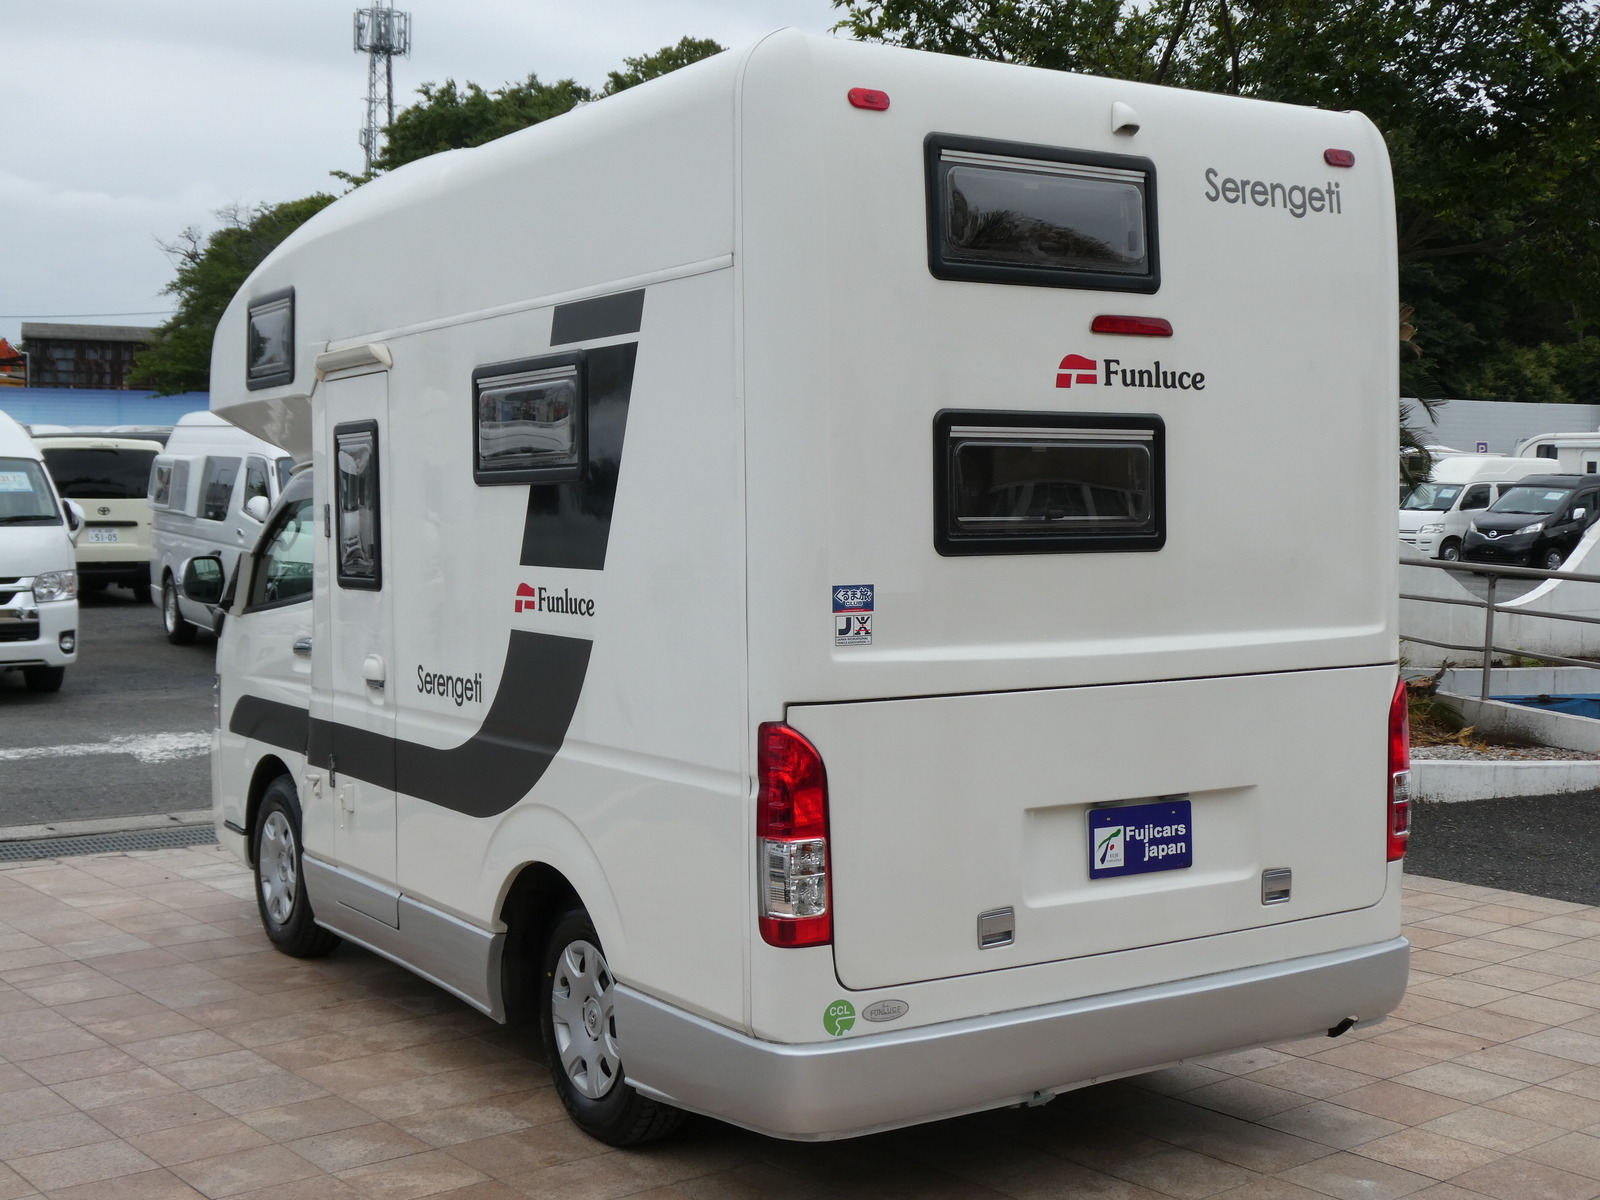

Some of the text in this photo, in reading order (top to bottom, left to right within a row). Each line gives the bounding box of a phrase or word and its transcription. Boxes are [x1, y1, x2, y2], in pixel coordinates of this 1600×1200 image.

[1204, 167, 1342, 219] Serengeti
[1103, 358, 1206, 391] Funluce
[537, 586, 595, 617] Funluce
[834, 587, 873, 603] くるま旅
[417, 664, 482, 707] Serengeti
[1125, 823, 1187, 842] Fujicars
[1143, 841, 1186, 862] japan
[829, 1005, 850, 1016] CCL
